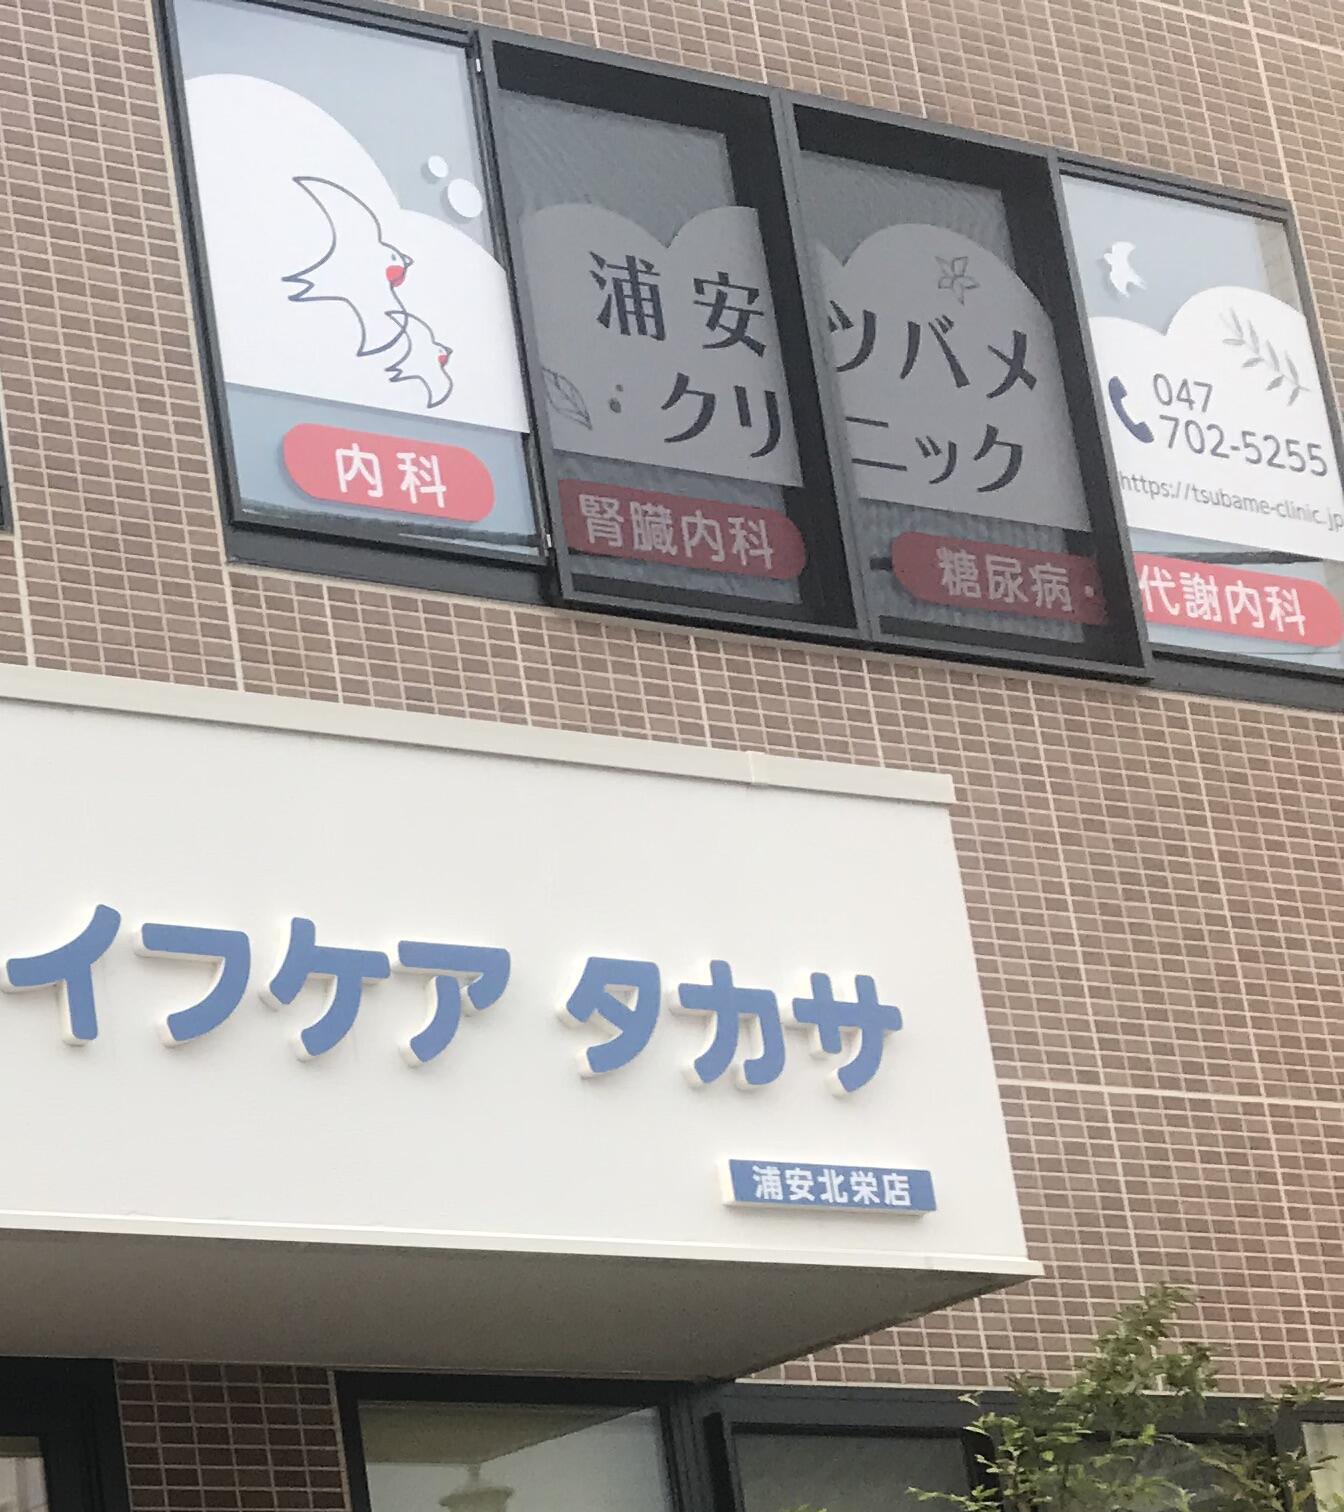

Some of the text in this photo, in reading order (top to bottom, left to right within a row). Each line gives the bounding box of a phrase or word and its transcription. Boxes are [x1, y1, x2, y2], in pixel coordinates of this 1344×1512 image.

[589, 251, 1038, 399] 浦安 ツバメ
[1152, 373, 1213, 413] 047
[661, 372, 1024, 493] クリ ニック
[1159, 414, 1329, 477] 702-5255
[335, 443, 447, 508] 内科
[579, 494, 774, 570] 腎臓内科
[1138, 564, 1306, 636] 代謝内科
[562, 957, 903, 1098] タカサ
[752, 1165, 911, 1206] 浦安北栄店
